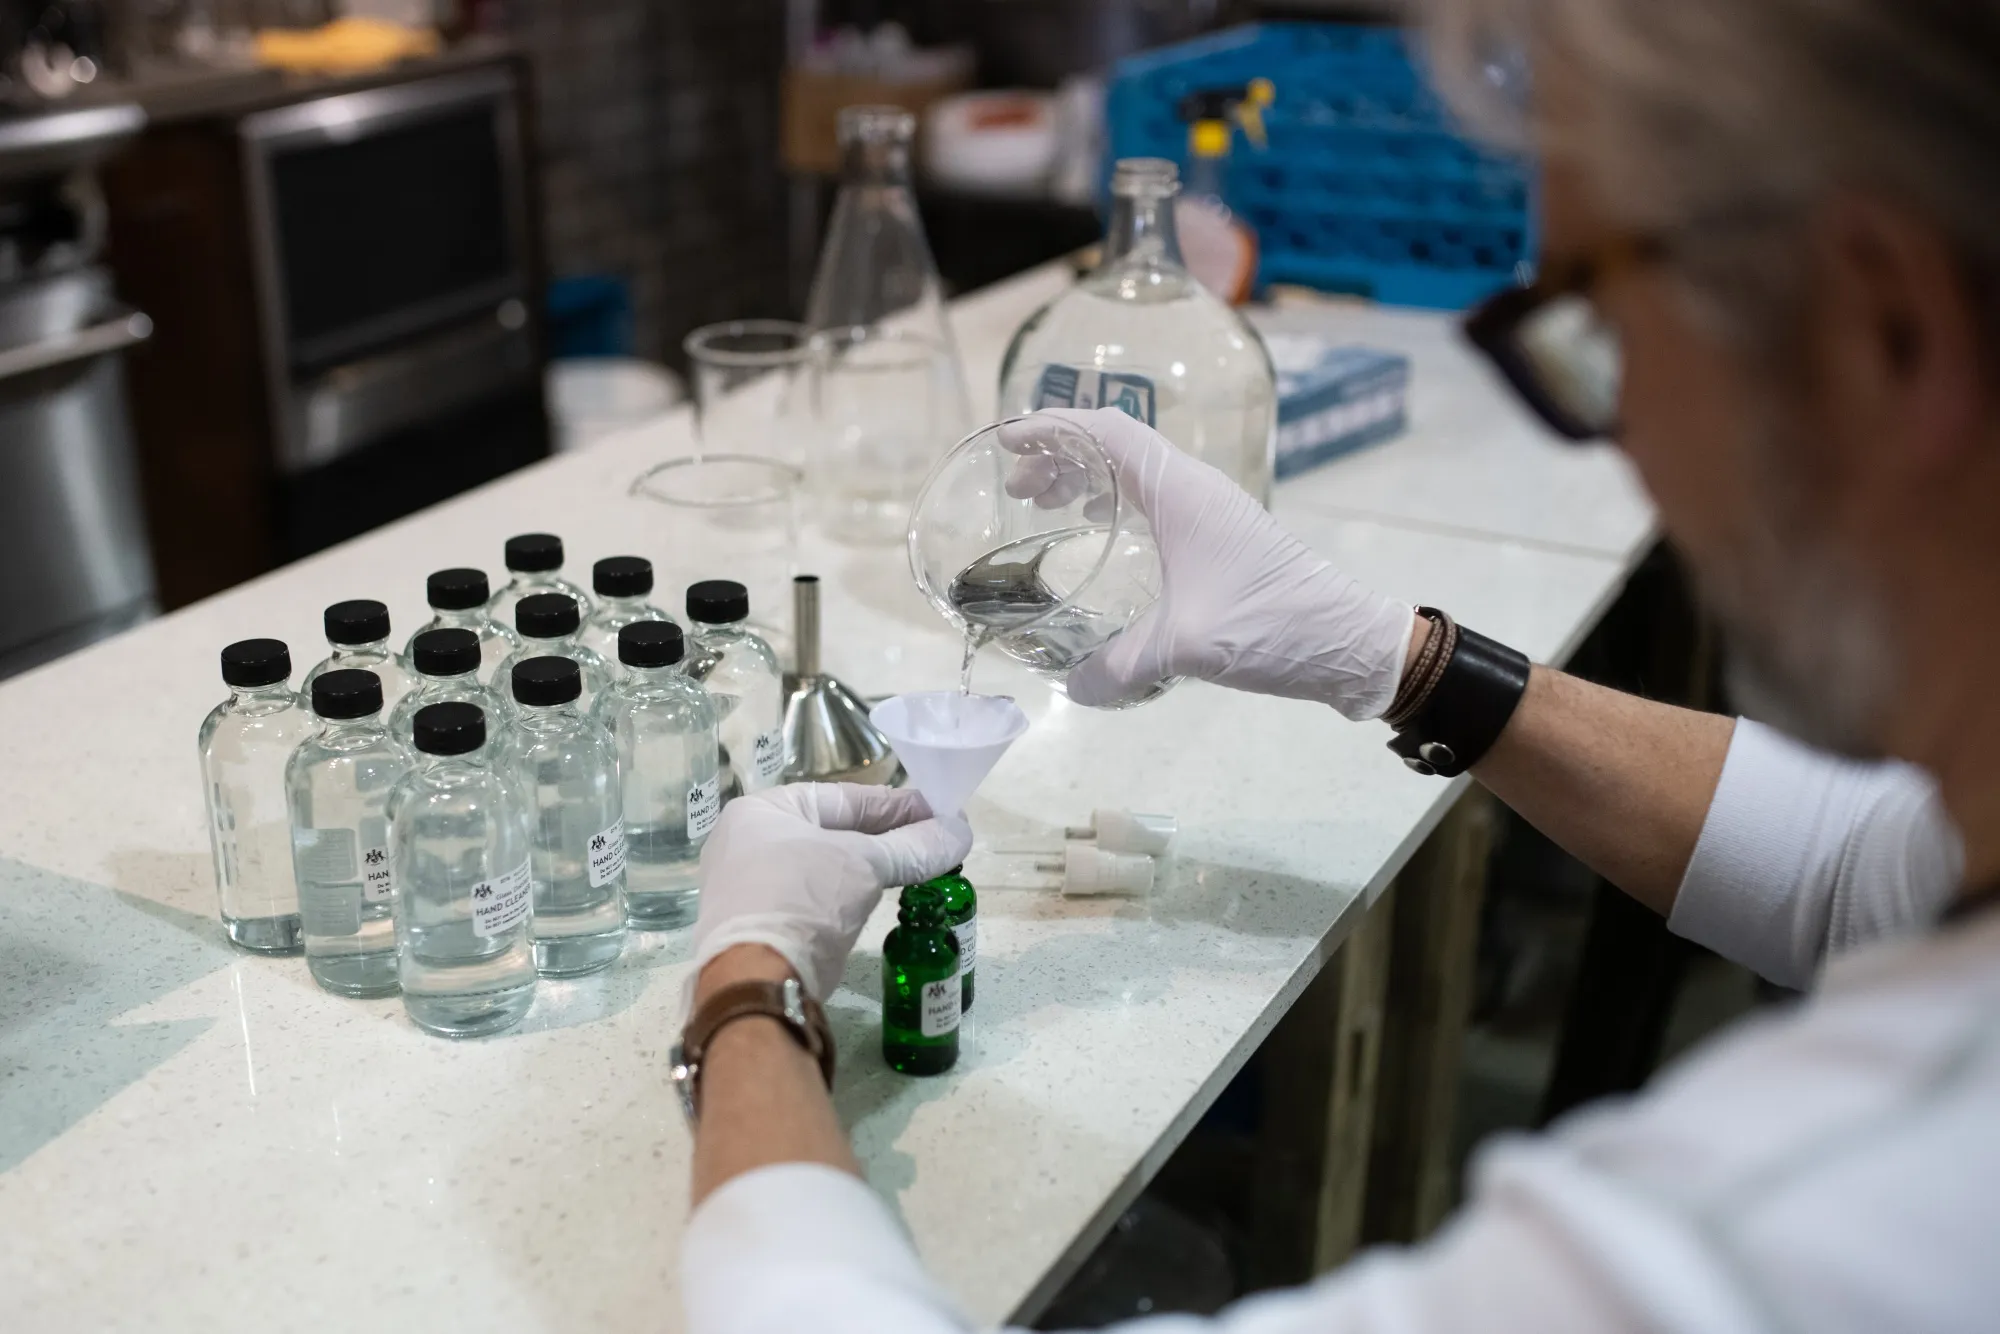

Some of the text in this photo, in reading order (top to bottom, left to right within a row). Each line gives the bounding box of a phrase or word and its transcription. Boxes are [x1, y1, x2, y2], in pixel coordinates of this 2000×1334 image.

[691, 806, 709, 819] HAND
[593, 852, 613, 867] HAND
[368, 870, 389, 880] HAN
[476, 902, 503, 916] HAND
